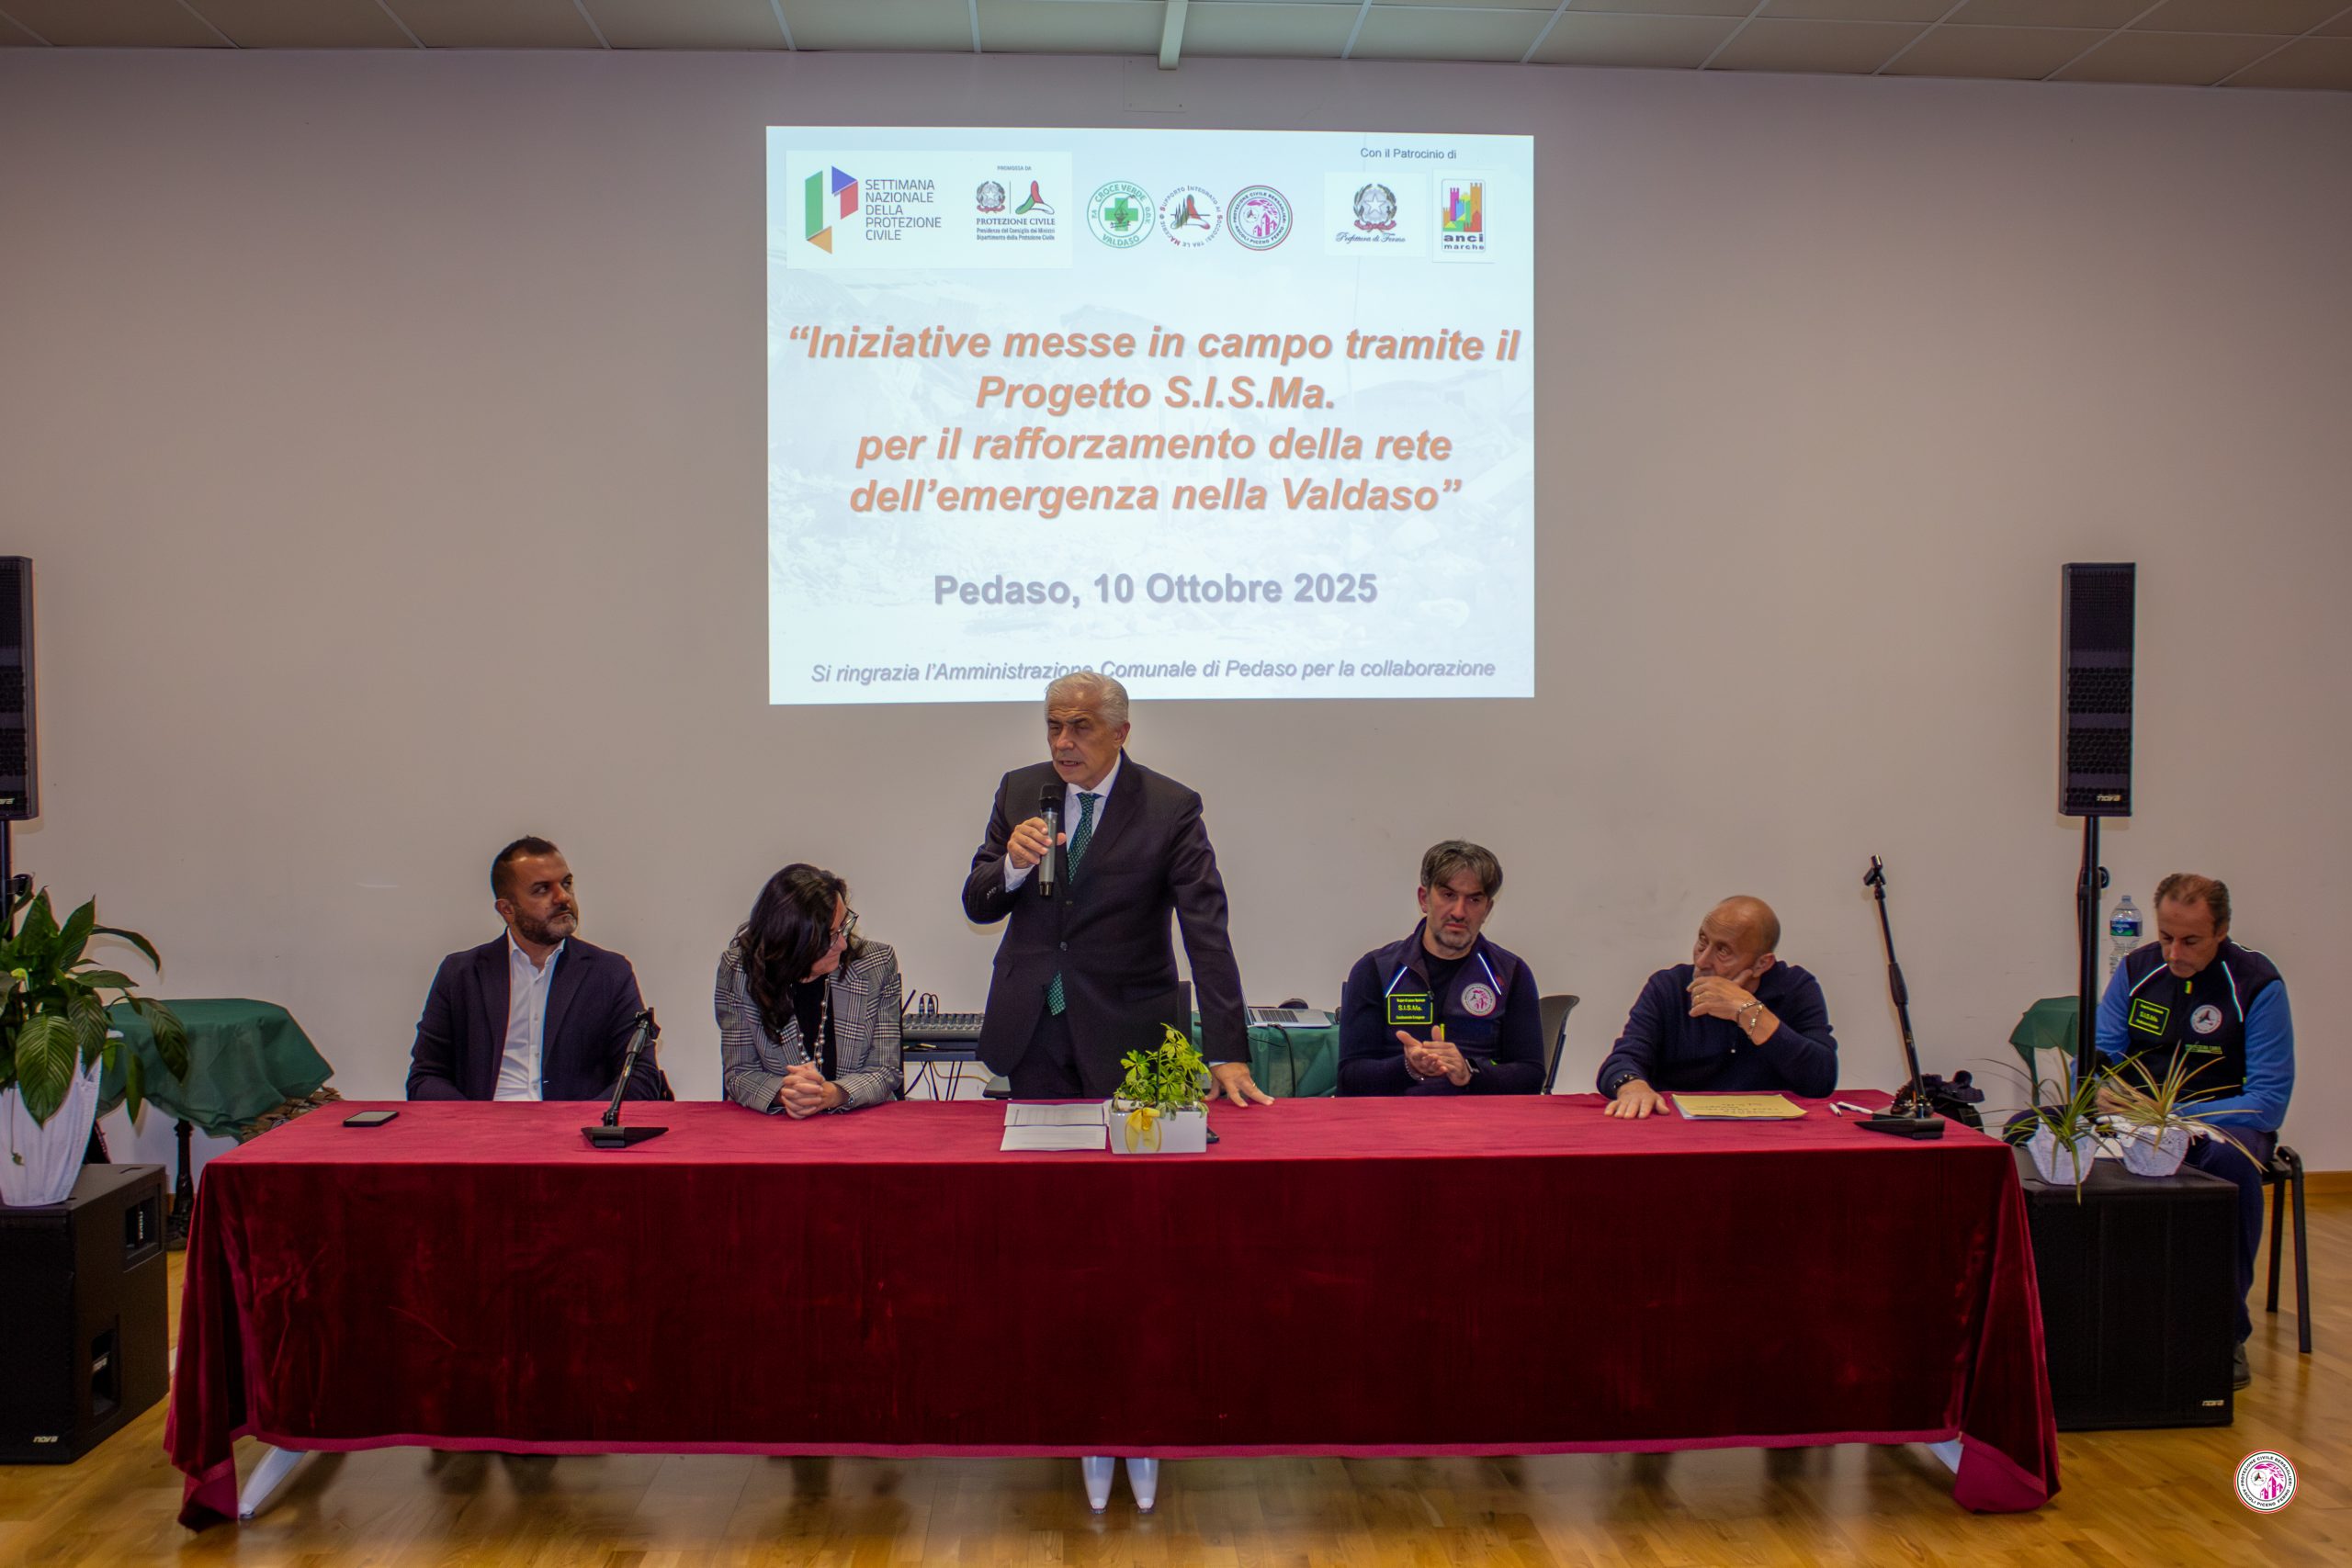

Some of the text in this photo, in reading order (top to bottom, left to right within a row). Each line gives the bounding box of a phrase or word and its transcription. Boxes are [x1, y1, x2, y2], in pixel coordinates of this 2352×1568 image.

[1361, 147, 1457, 160] Con il Patrocinio di
[865, 178, 935, 190] SETTIMANA
[865, 191, 934, 203] NAZIONALE
[1094, 183, 1148, 203] CROCE VERDE
[865, 204, 904, 216] DELLA
[865, 217, 942, 228] PROTEZIONE
[976, 218, 1056, 226] PROTEZIONE CIVILE
[865, 229, 902, 241] CIVILE
[1102, 233, 1140, 246] VALDASO
[1443, 233, 1484, 243] anci
[1443, 243, 1485, 251] marche
[789, 325, 1521, 367] “Iniziative messe in campo tramite il
[976, 375, 1334, 417] Progetto S.I.S.Ma.
[855, 426, 1453, 469] per il rafforzamento della rete
[850, 477, 1463, 520] dell’emergenza nella Valdaso”
[933, 572, 1378, 609] Pedaso, 10 Ottobre 2025
[811, 664, 832, 682] Si
[836, 663, 920, 686] ringrazia
[1101, 660, 1197, 679] Comunale
[1203, 660, 1221, 678] di
[1226, 660, 1297, 678] Pedaso
[1301, 663, 1333, 682] per
[1339, 660, 1355, 677] la
[1361, 659, 1497, 677] collaborazione
